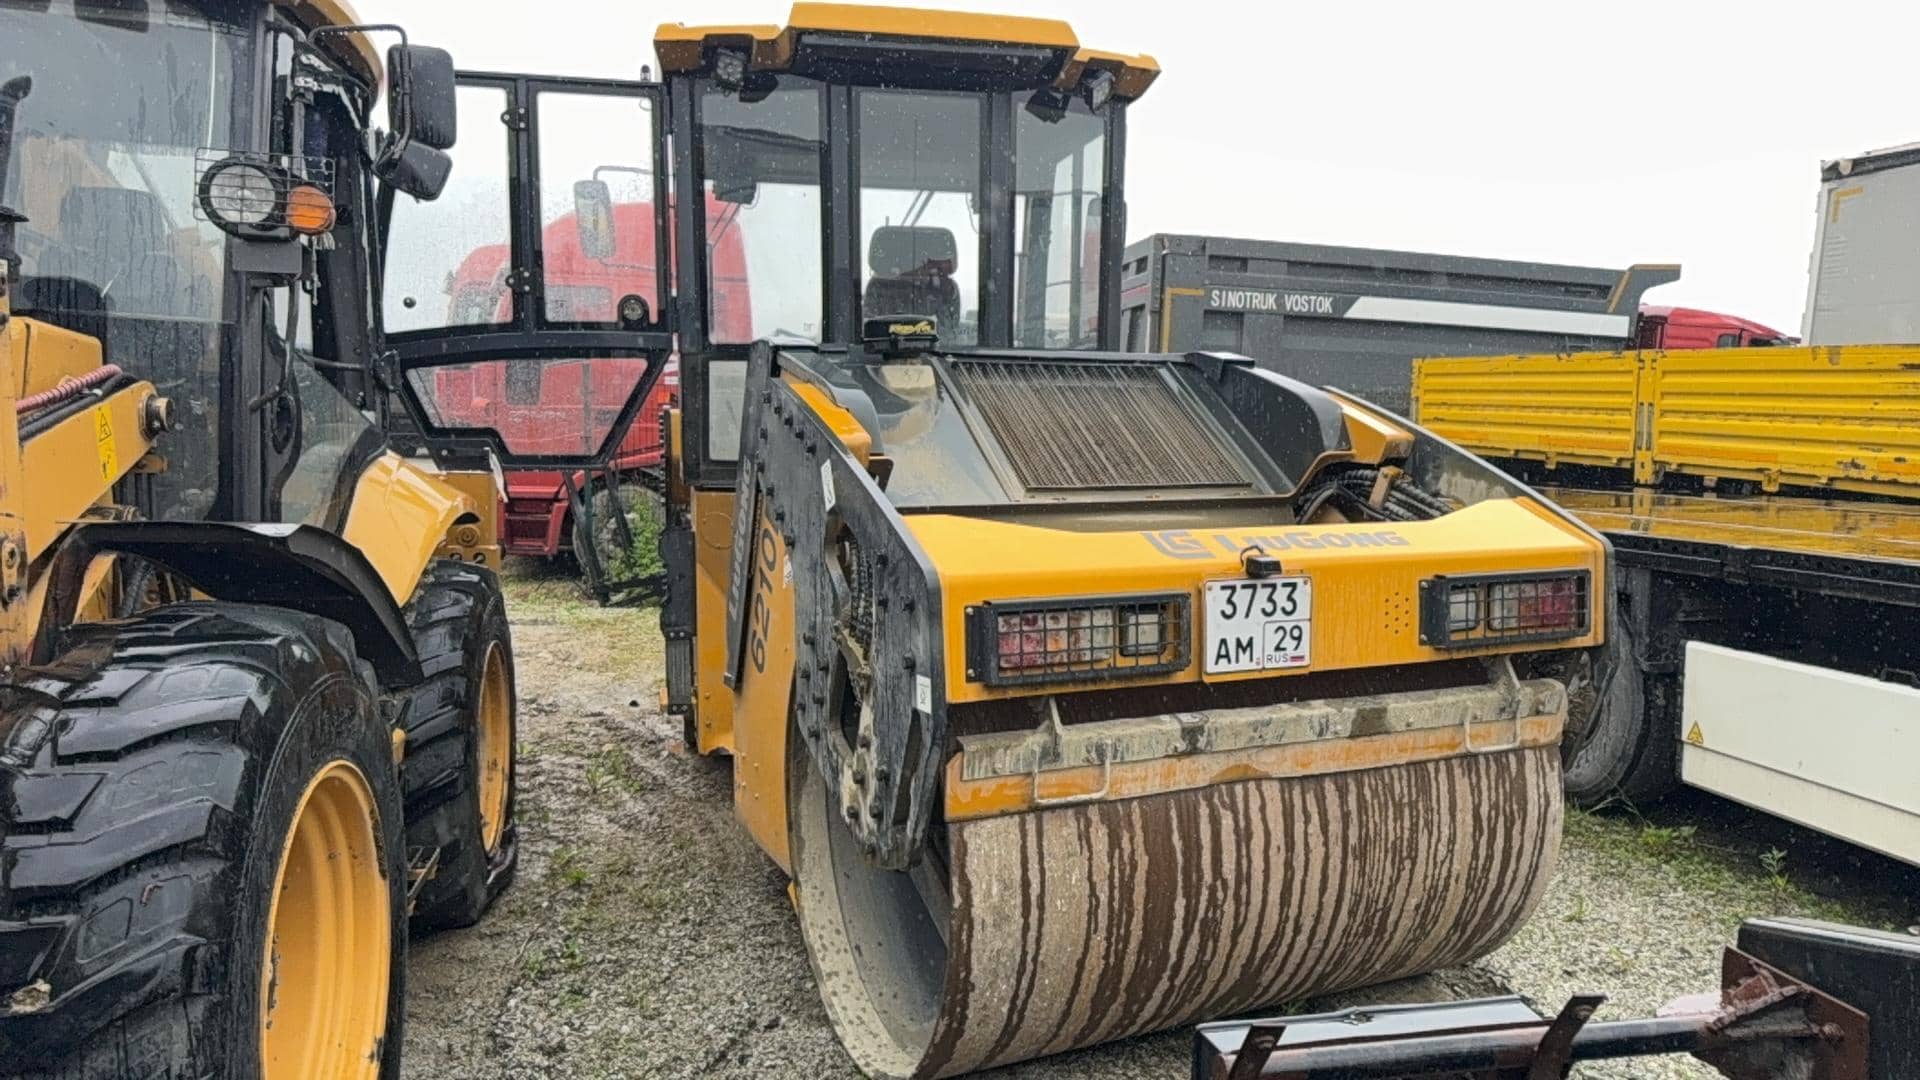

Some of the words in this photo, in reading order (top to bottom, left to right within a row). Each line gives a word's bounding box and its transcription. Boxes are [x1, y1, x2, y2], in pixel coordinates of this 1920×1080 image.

[1211, 289, 1277, 310] SINOTRUK
[1284, 294, 1334, 313] VOSTOK
[752, 528, 776, 674] 6210
[1219, 581, 1298, 620] 3733
[1274, 624, 1303, 652] 29
[1266, 653, 1289, 664] RUS
